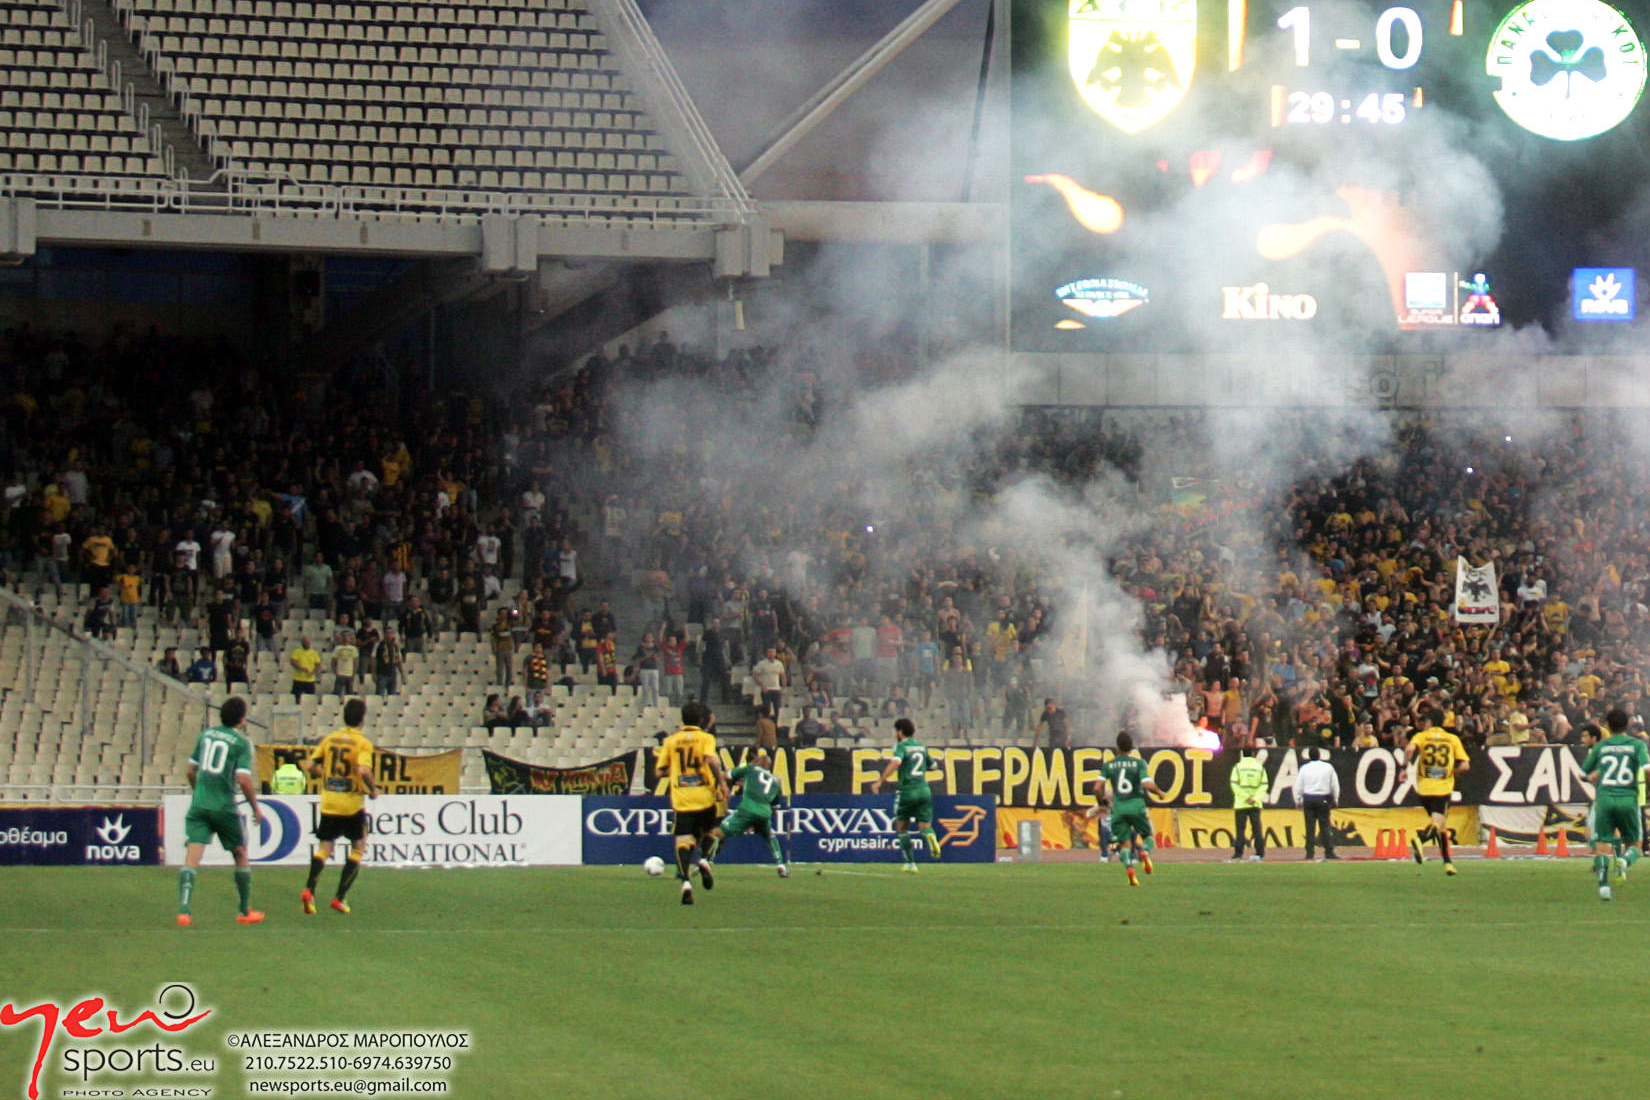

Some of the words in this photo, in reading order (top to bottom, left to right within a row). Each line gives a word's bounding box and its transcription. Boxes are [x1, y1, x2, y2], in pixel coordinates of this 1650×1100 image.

[1286, 91, 1406, 125] 29:45
[202, 737, 230, 774] 10
[329, 746, 351, 778] 15
[675, 746, 702, 774] 14
[911, 752, 924, 776] 2
[1423, 743, 1450, 767] 33
[1117, 768, 1133, 794] 6
[1600, 755, 1634, 785] 26
[438, 800, 523, 835] Club
[87, 844, 140, 860] nova
[819, 836, 923, 852] cyprusair.cm
